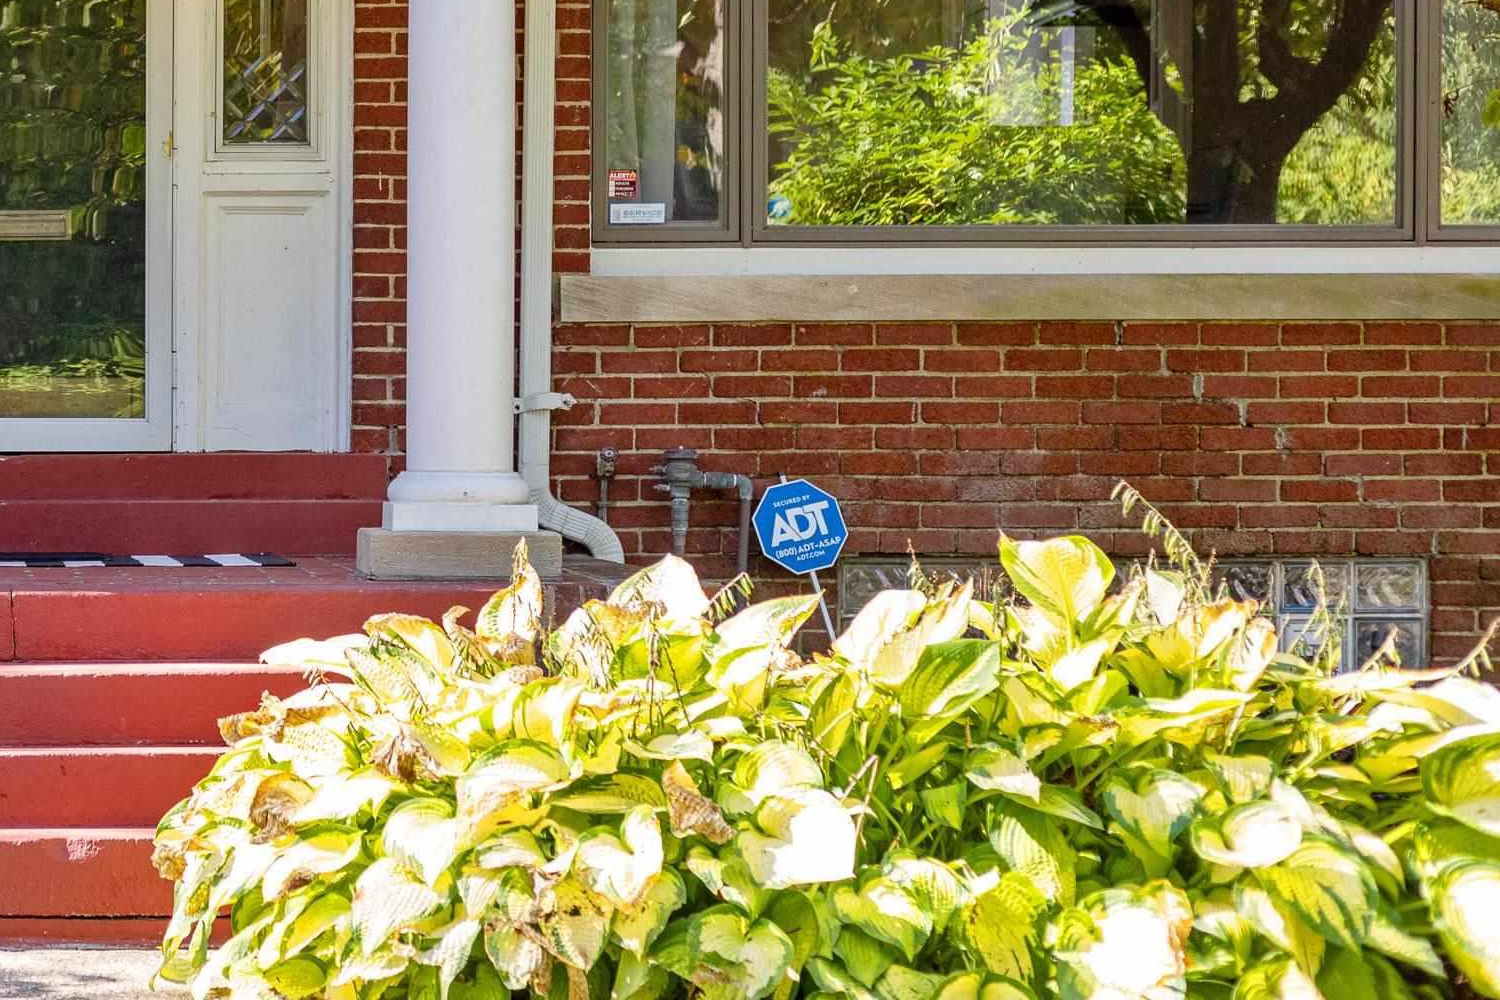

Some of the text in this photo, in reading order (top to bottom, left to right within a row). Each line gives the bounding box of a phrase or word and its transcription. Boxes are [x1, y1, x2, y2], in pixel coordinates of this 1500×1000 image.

[773, 496, 801, 508] SECURED
[771, 500, 829, 548] ADT
[775, 536, 842, 560] (800) ADT-ASAP
[796, 550, 826, 561] ADT.COM
